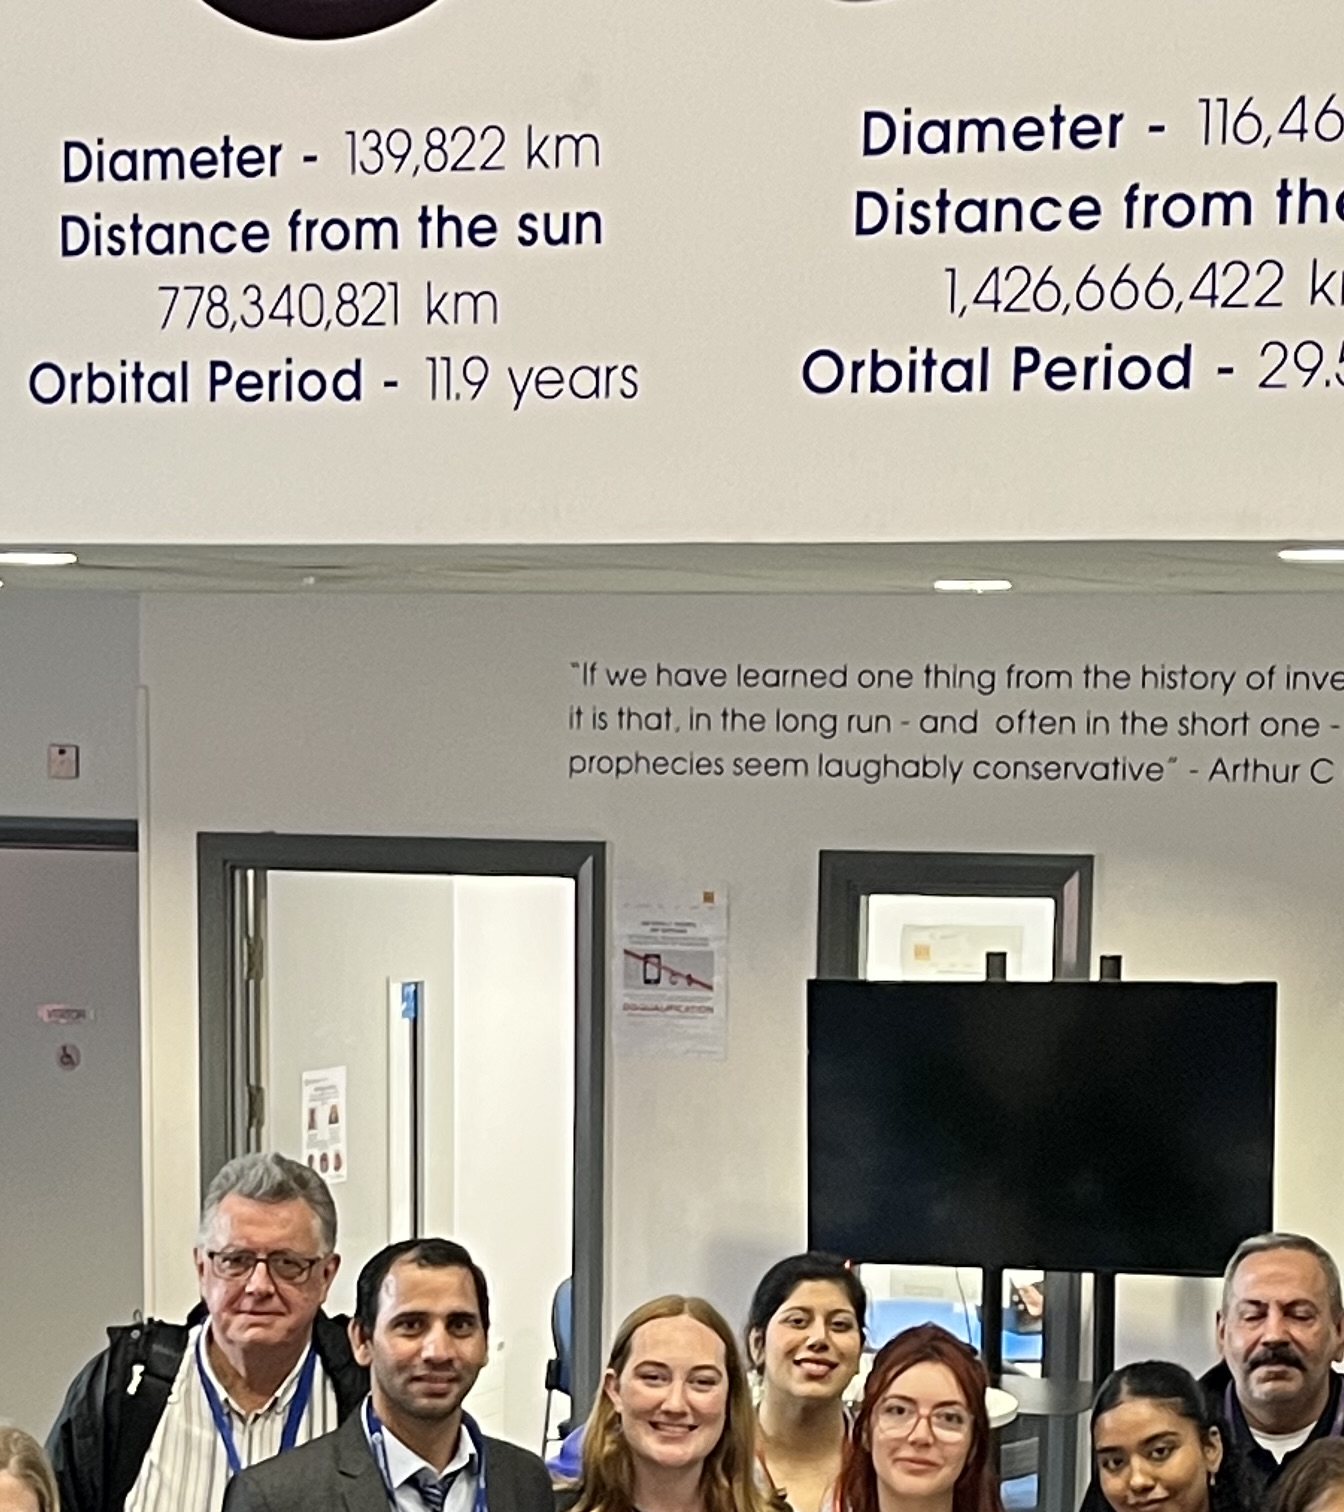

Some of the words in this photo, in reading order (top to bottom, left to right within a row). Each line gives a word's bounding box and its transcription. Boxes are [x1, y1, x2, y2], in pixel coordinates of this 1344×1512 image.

[63, 134, 283, 184] Diameter
[345, 124, 506, 178] 139,822
[527, 124, 600, 170] km
[862, 103, 1125, 157] Diameter
[61, 211, 270, 258] Distance
[287, 208, 399, 252] from
[417, 204, 498, 249] the
[517, 211, 602, 247] sun
[855, 187, 1102, 236] Distance
[1123, 182, 1252, 229] from
[158, 281, 399, 333] 778,340,821
[426, 280, 498, 325] km
[944, 259, 1284, 319] 1,426,666,422
[29, 359, 188, 405] Orbital
[209, 357, 362, 403] Period
[425, 355, 489, 401] 11.9
[507, 364, 638, 411] years
[802, 345, 989, 395] Orbital
[1013, 342, 1192, 392] Period
[605, 667, 647, 687] we
[656, 662, 727, 688] have
[737, 663, 848, 689] learned
[857, 669, 914, 689] one
[923, 663, 996, 696] thing
[1006, 663, 1073, 690] from
[1083, 664, 1131, 690] the
[1141, 664, 1237, 697] history
[1245, 665, 1276, 691] of
[569, 705, 583, 730] it
[592, 706, 609, 731] is
[617, 706, 680, 733] that,
[689, 707, 712, 731] in
[721, 707, 766, 733] the
[775, 708, 837, 740] long
[847, 714, 891, 734] run
[919, 709, 978, 735] and
[995, 708, 1076, 735] often
[1086, 710, 1110, 735] in
[1120, 710, 1168, 737] the
[1177, 711, 1250, 737] short
[1260, 717, 1320, 738] one
[568, 751, 725, 780] prophecies
[732, 757, 809, 777] seem
[818, 753, 964, 785] laughably
[1208, 757, 1301, 784] Arthur
[1310, 757, 1334, 785] C
